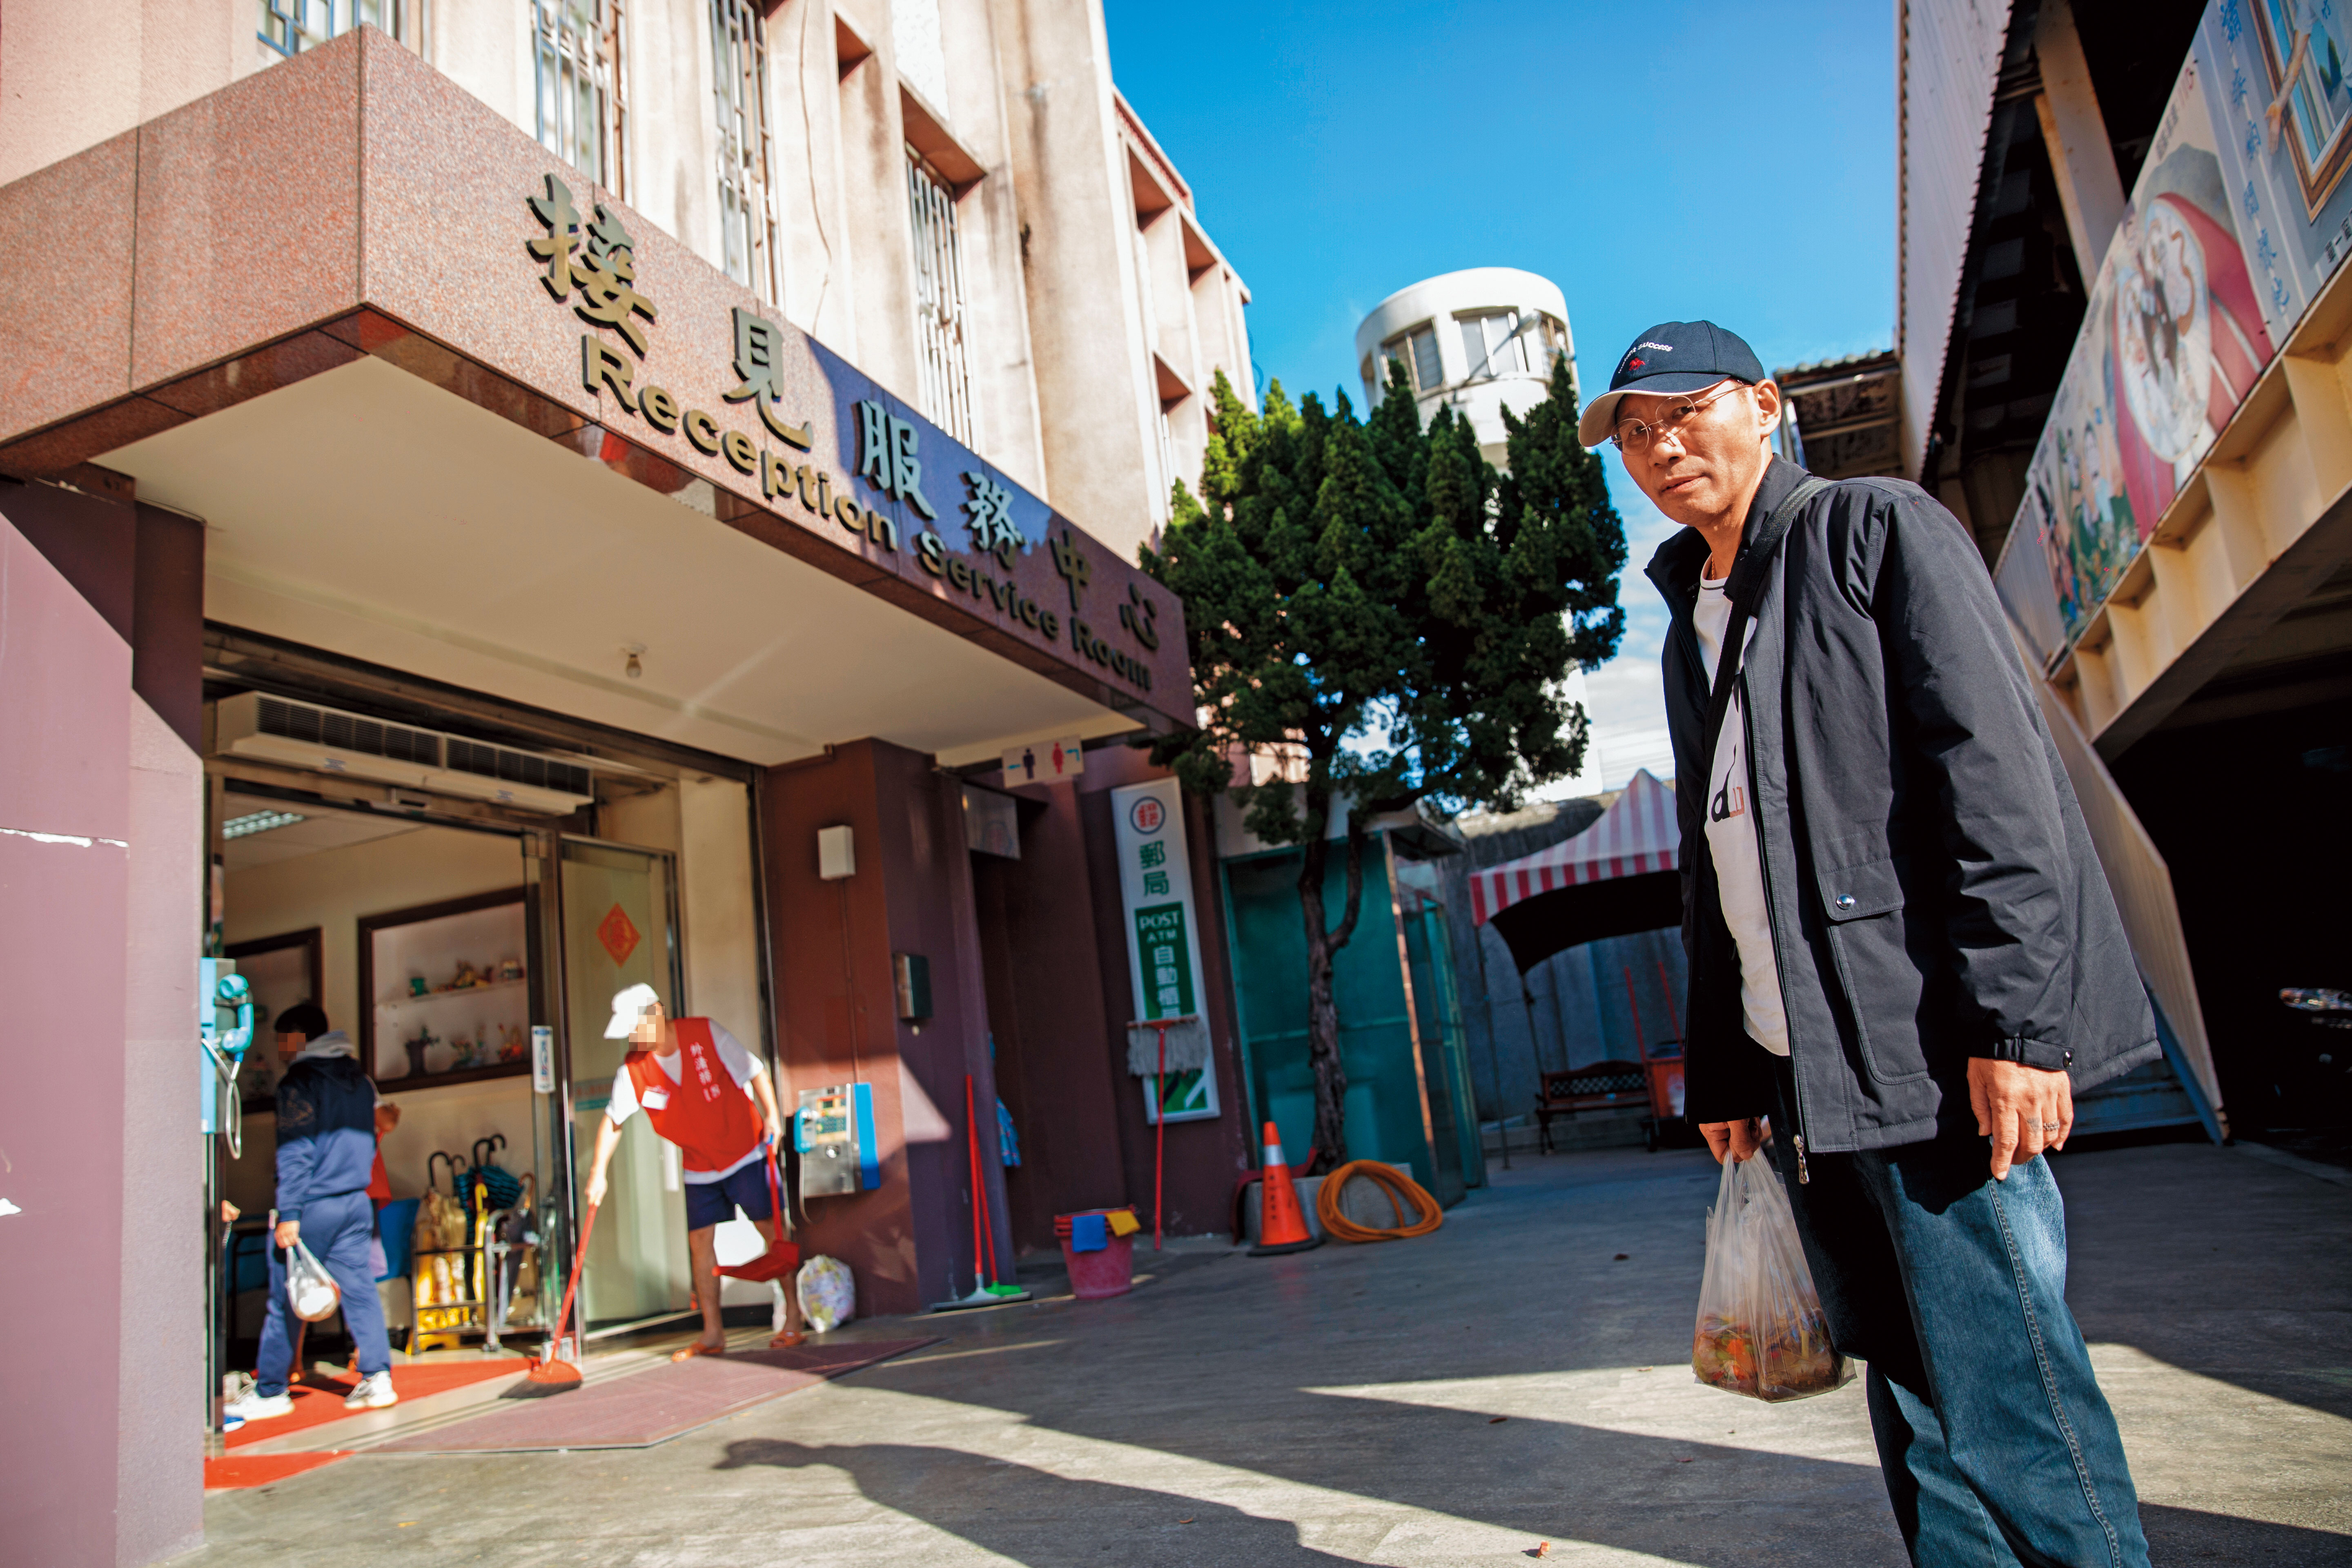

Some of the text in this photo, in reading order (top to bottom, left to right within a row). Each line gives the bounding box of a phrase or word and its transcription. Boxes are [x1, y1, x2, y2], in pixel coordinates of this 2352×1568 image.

[1637, 341, 1673, 352] success
[526, 173, 1160, 650] 接見服務中心
[581, 334, 1152, 690] Reception Service Room
[1139, 840, 1170, 897] 郵局
[1139, 910, 1180, 931] POST
[1147, 928, 1178, 944] ATM
